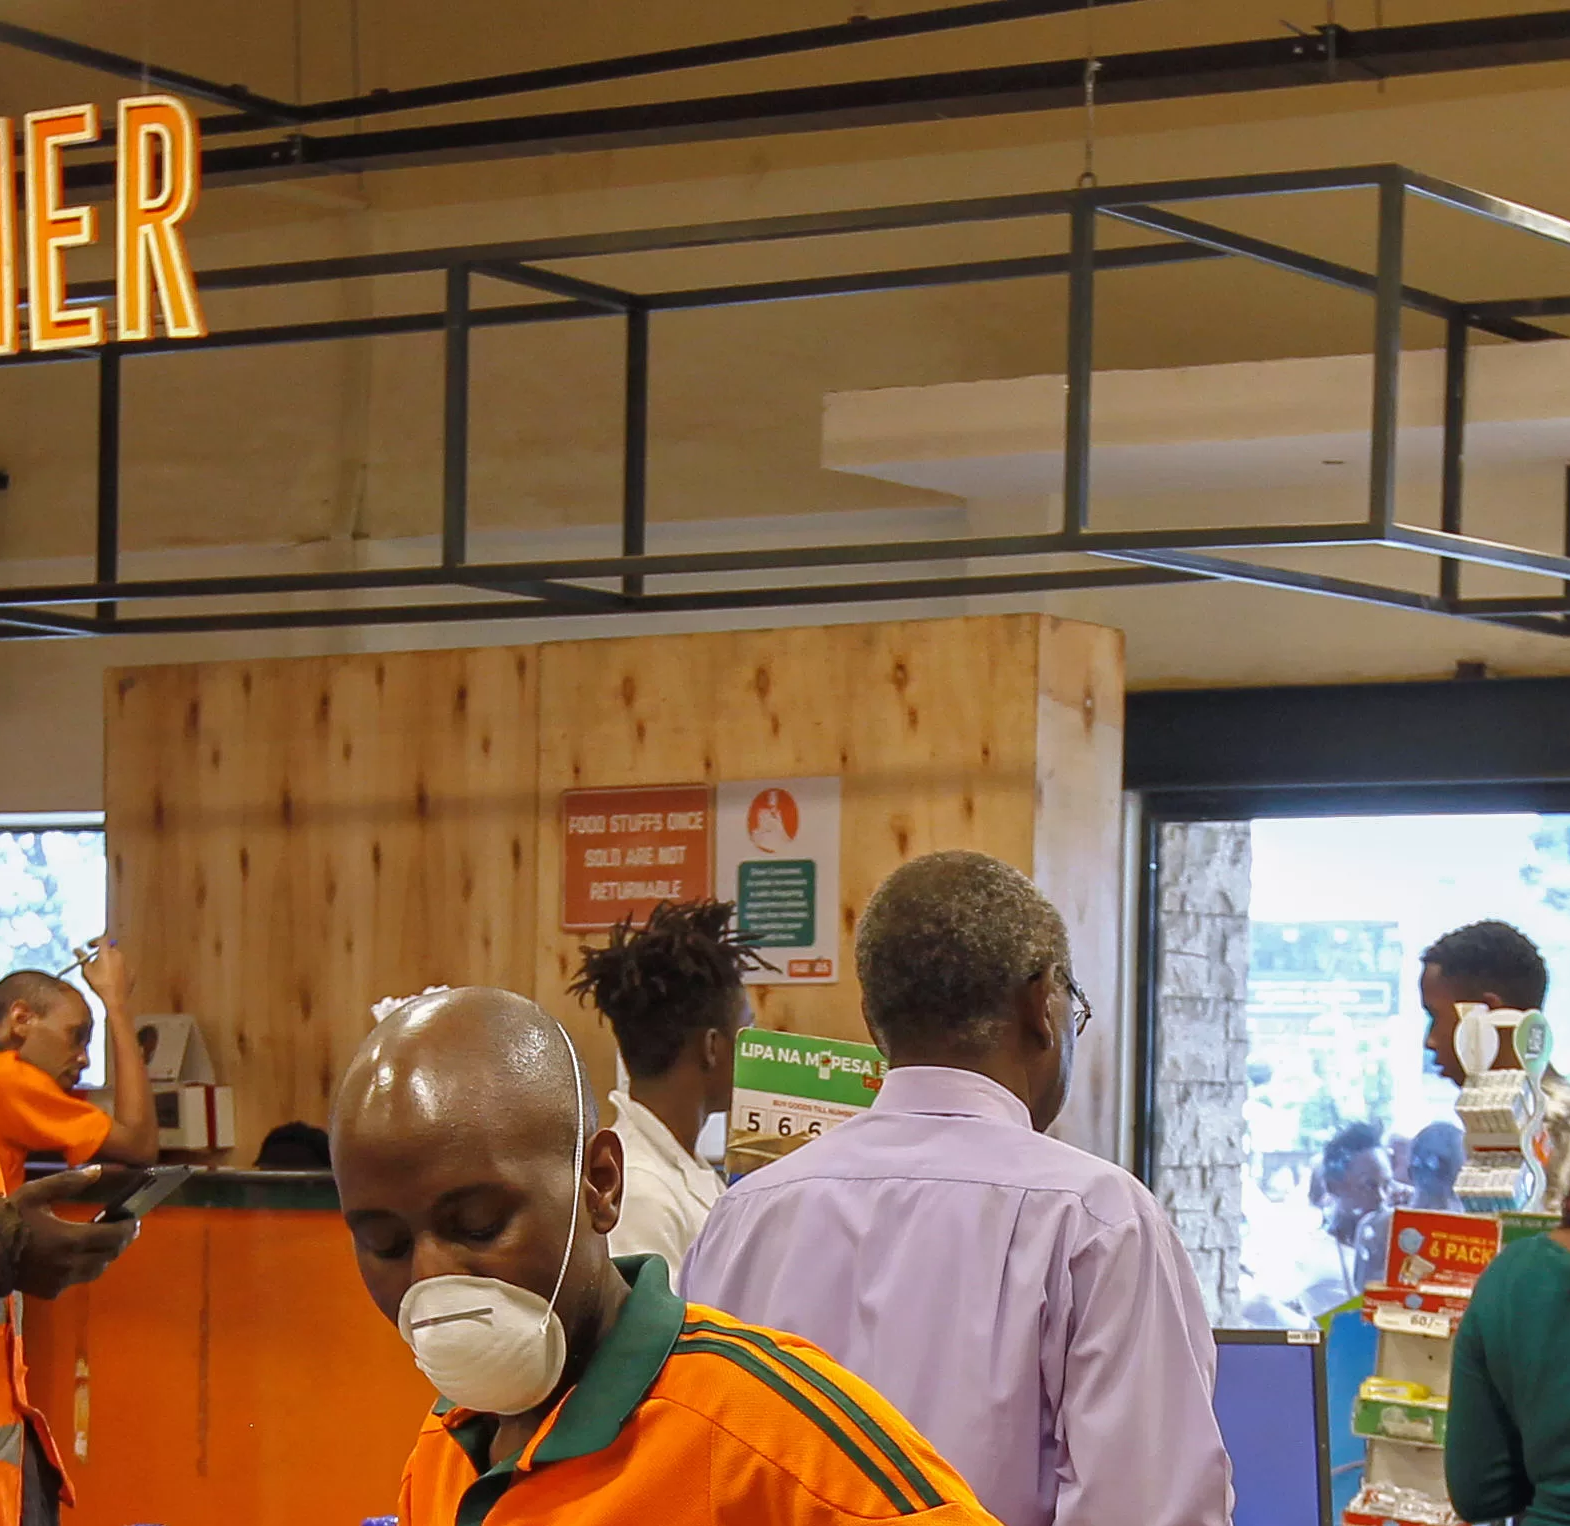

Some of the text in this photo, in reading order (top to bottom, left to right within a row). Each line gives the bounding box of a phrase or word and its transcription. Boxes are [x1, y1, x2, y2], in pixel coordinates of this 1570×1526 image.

[568, 811, 704, 834] FOOD STUFFS ONCE
[584, 845, 687, 867] SOLD ARE NOT
[589, 879, 682, 901] RETURNABLE
[741, 1042, 775, 1059] LIPA
[777, 1048, 801, 1064] NA
[747, 1112, 761, 1132] 5
[778, 1117, 792, 1137] 6
[1429, 1240, 1440, 1259] 6
